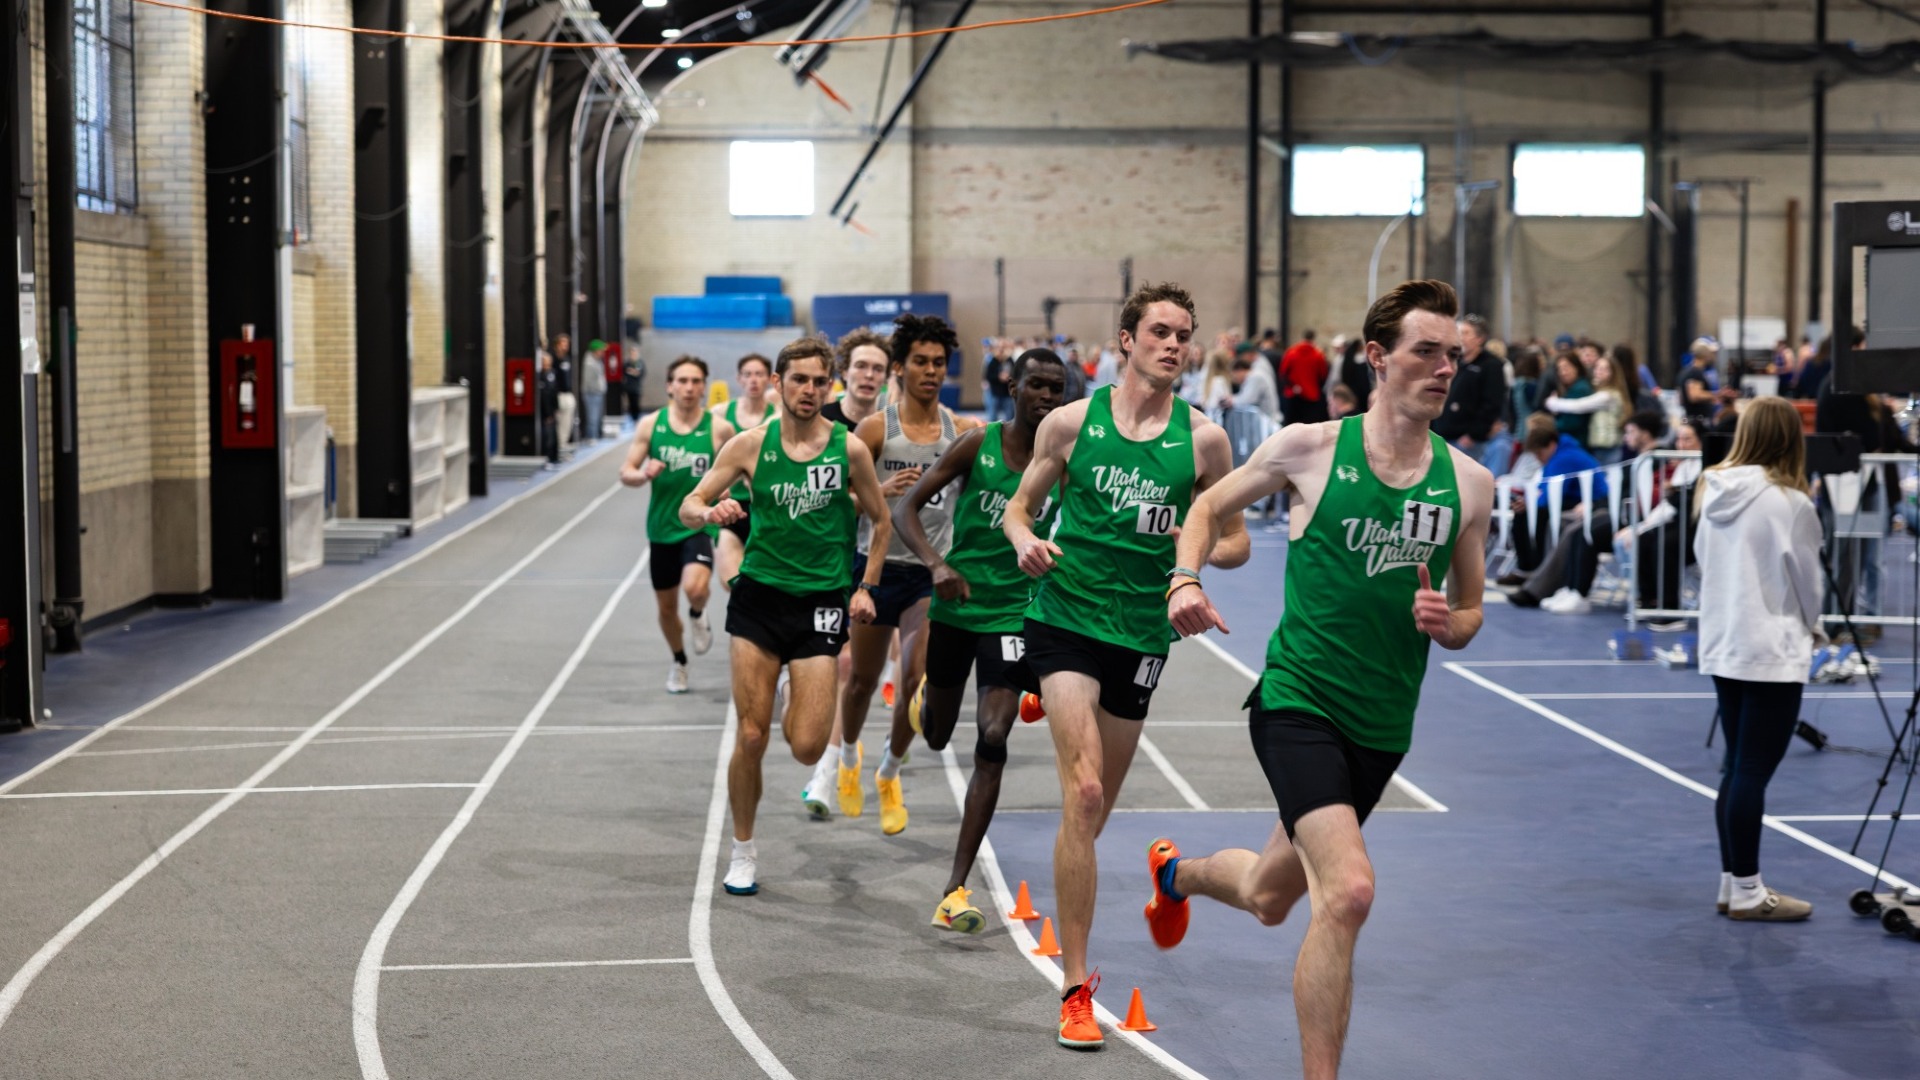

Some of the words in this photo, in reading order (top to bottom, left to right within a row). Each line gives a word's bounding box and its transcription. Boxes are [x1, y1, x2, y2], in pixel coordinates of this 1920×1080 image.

[695, 457, 707, 475] 9
[810, 466, 836, 490] 12
[885, 460, 917, 471] UTAH
[1092, 465, 1140, 493] Utah
[770, 482, 809, 506] Utah
[785, 491, 832, 520] Valley
[979, 490, 1009, 512] Uta
[1108, 479, 1171, 513] Valley
[1146, 506, 1171, 534] 10
[1407, 503, 1441, 542] 11
[1341, 517, 1402, 552] Utah
[1362, 538, 1437, 578] Valley
[817, 608, 840, 632] 12
